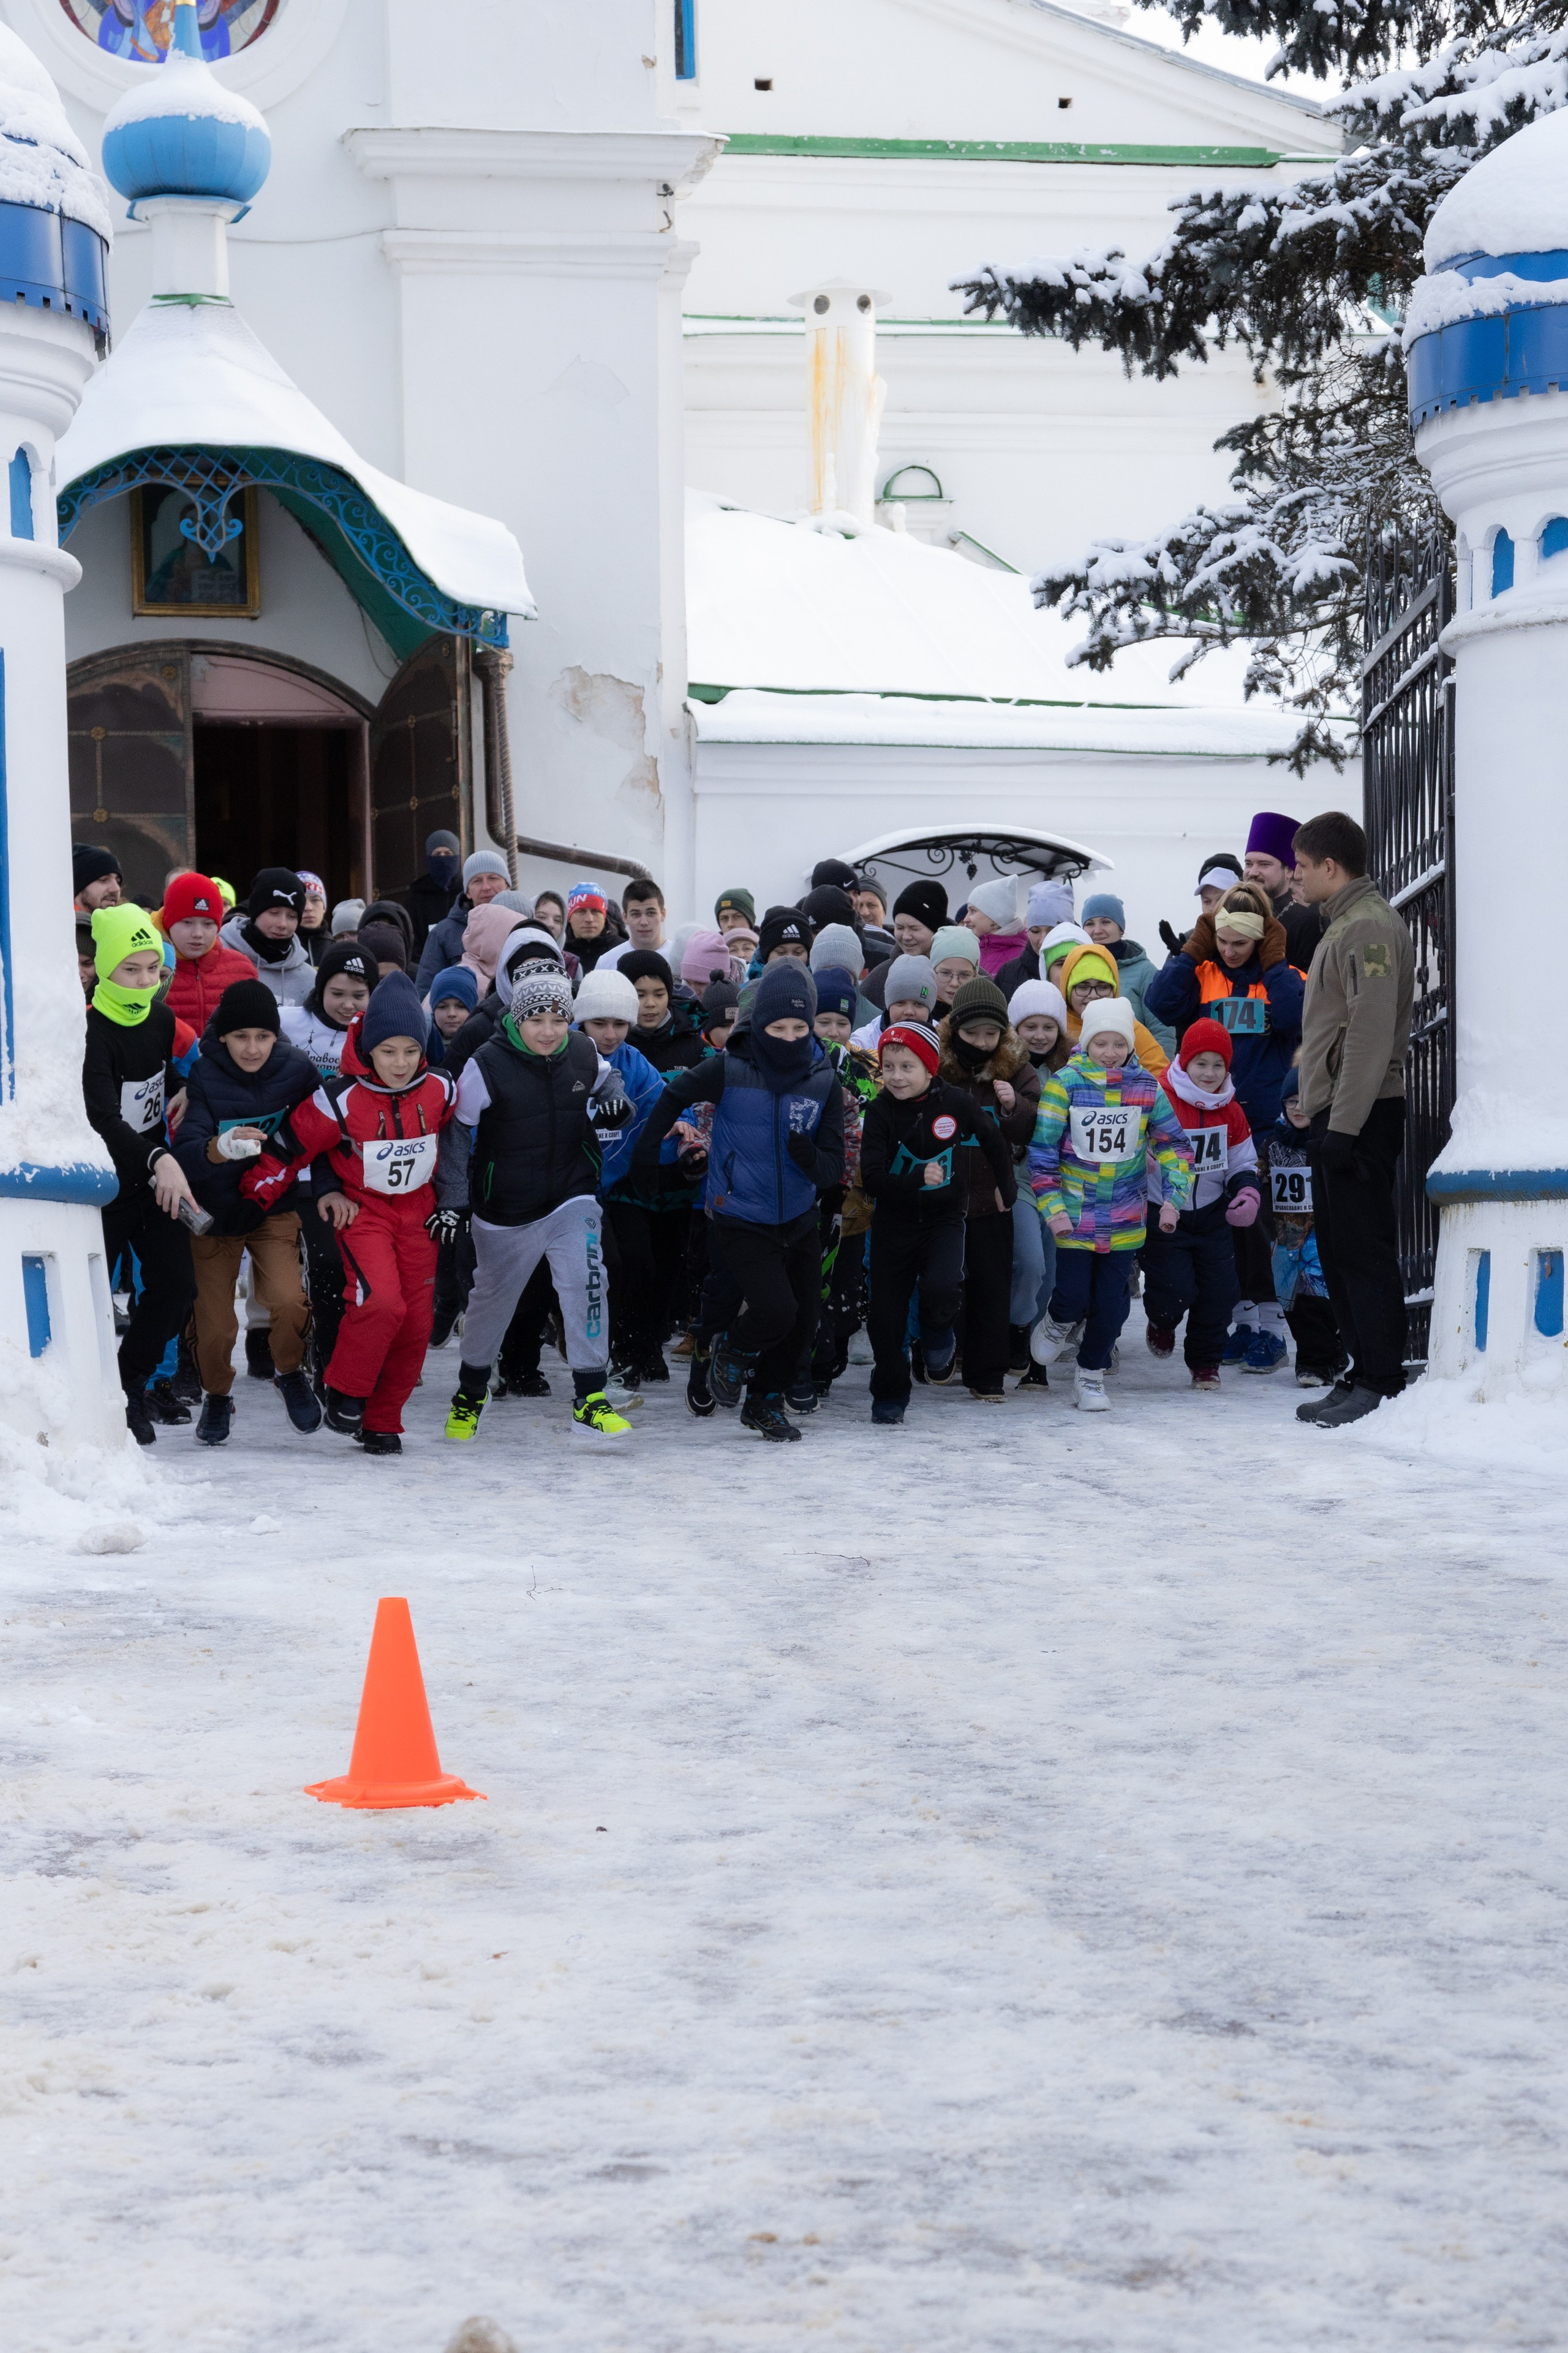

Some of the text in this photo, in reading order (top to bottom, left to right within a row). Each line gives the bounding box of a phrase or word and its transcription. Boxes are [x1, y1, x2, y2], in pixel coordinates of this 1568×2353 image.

[344, 965, 365, 974] adidas
[1215, 1000, 1257, 1030] 174
[142, 1092, 161, 1125] 26
[1097, 1113, 1128, 1125] asics
[394, 1142, 426, 1157] asics
[1085, 1128, 1126, 1153] 154
[1191, 1132, 1221, 1164] 74
[387, 1158, 415, 1187] 57
[586, 1232, 601, 1339] carbrini
